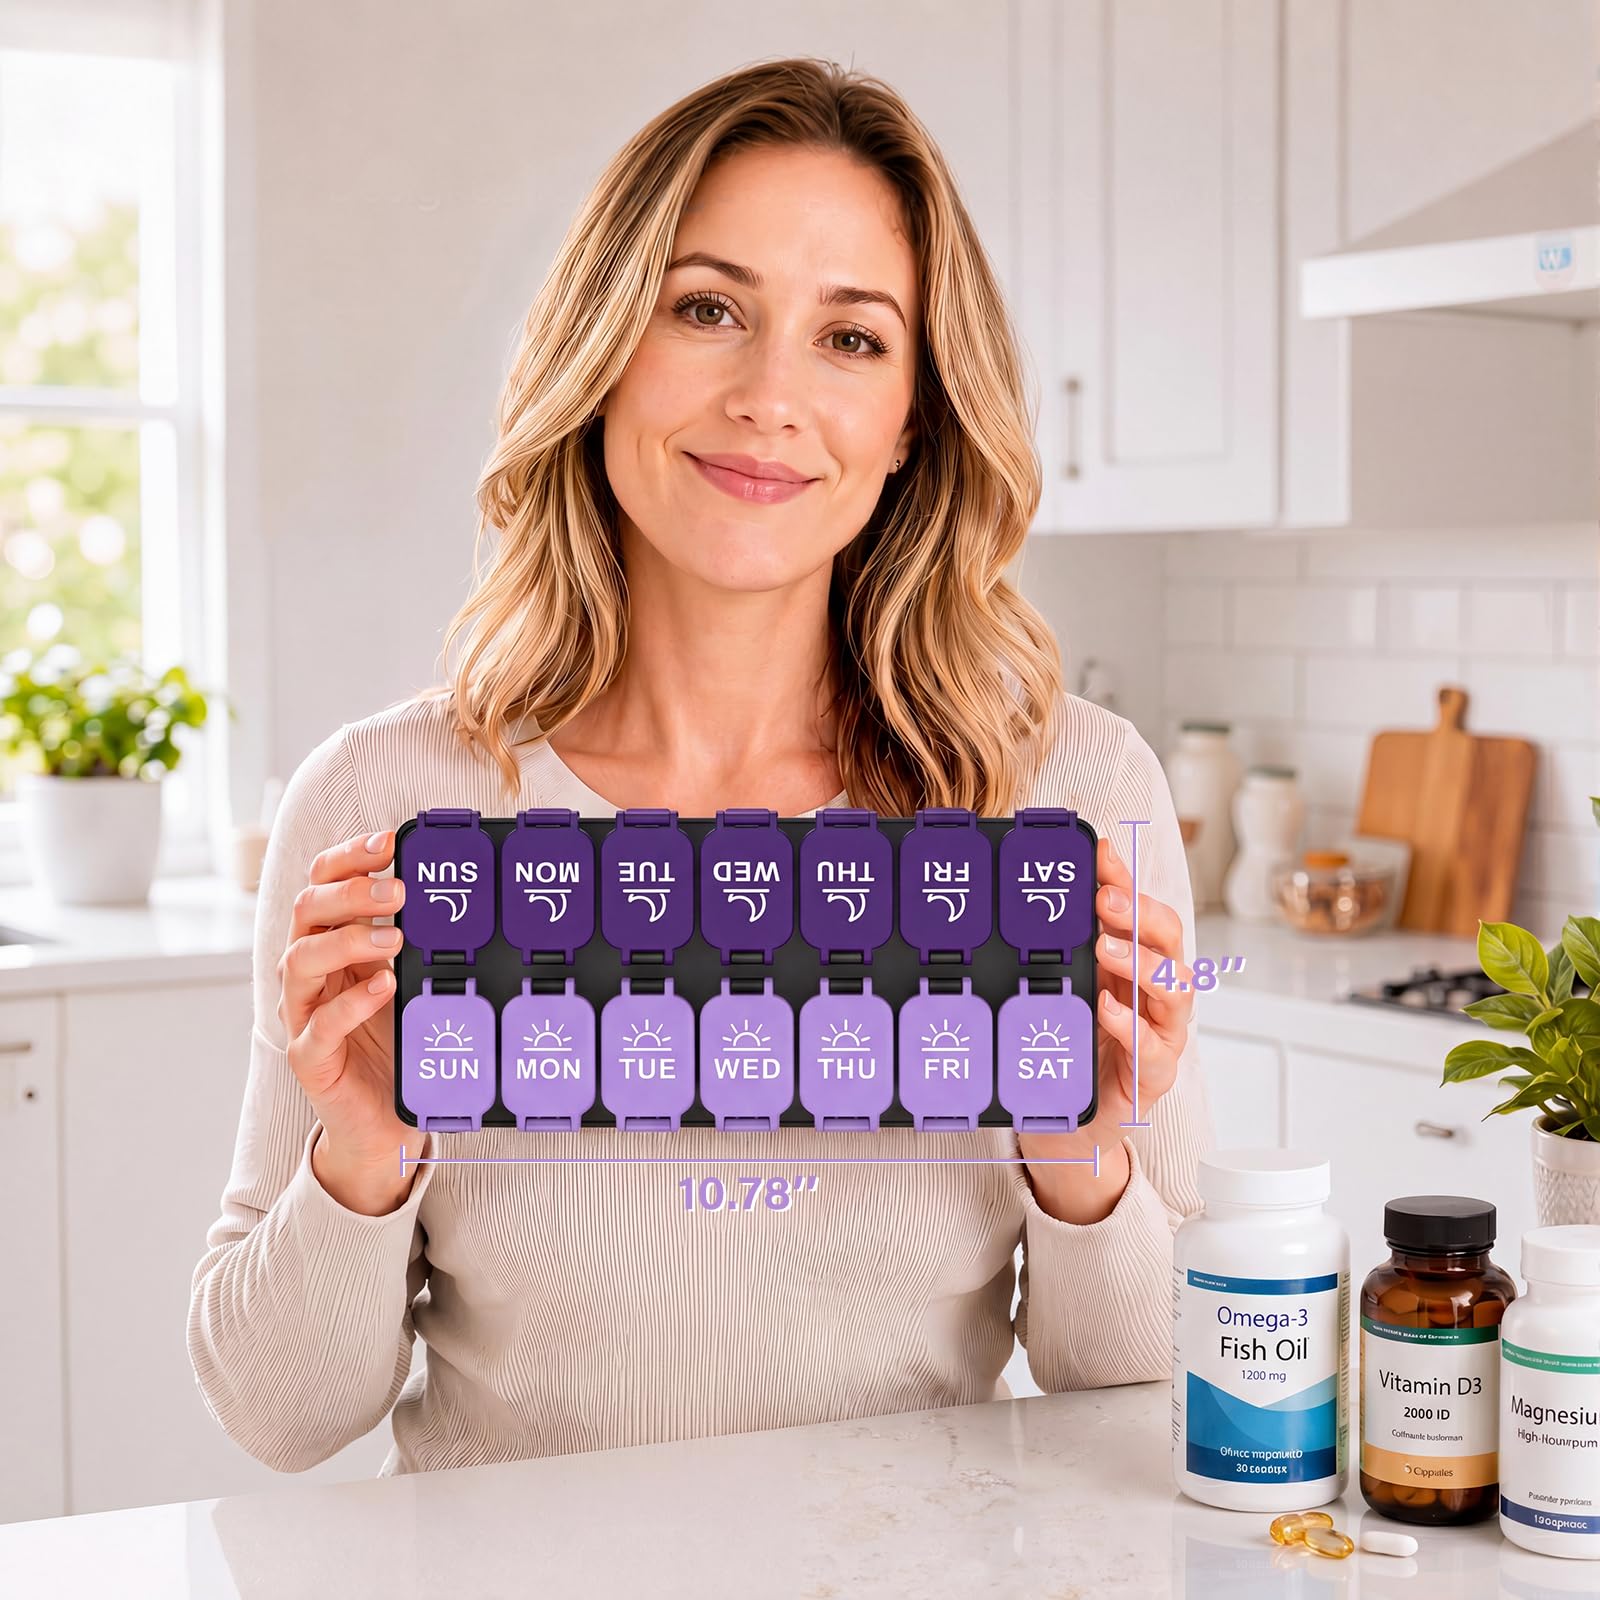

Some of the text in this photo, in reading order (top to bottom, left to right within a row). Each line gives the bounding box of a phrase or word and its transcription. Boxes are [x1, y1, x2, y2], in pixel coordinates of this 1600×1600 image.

[418, 862, 478, 883] SUN
[515, 862, 580, 883] MON
[618, 862, 676, 883] TUE
[713, 861, 781, 883] WED
[817, 862, 875, 883] THU
[924, 861, 970, 882] FRI
[1018, 861, 1076, 883] SAT
[418, 1058, 479, 1080] SUN
[516, 1058, 581, 1080] MON
[618, 1058, 676, 1080] TUE
[714, 1058, 781, 1080] WED
[817, 1058, 876, 1080] THU
[924, 1058, 970, 1080] FRI
[1017, 1058, 1074, 1080] SAT
[1217, 1306, 1309, 1332] Omega-3
[1220, 1336, 1309, 1361] Fish Oil
[1241, 1369, 1287, 1383] 1200 mg
[1379, 1369, 1482, 1396] Vitamin D3
[1403, 1406, 1450, 1421] 2000 ID
[1511, 1395, 1600, 1426] Magnesiu
[1236, 1463, 1248, 1473] 30
